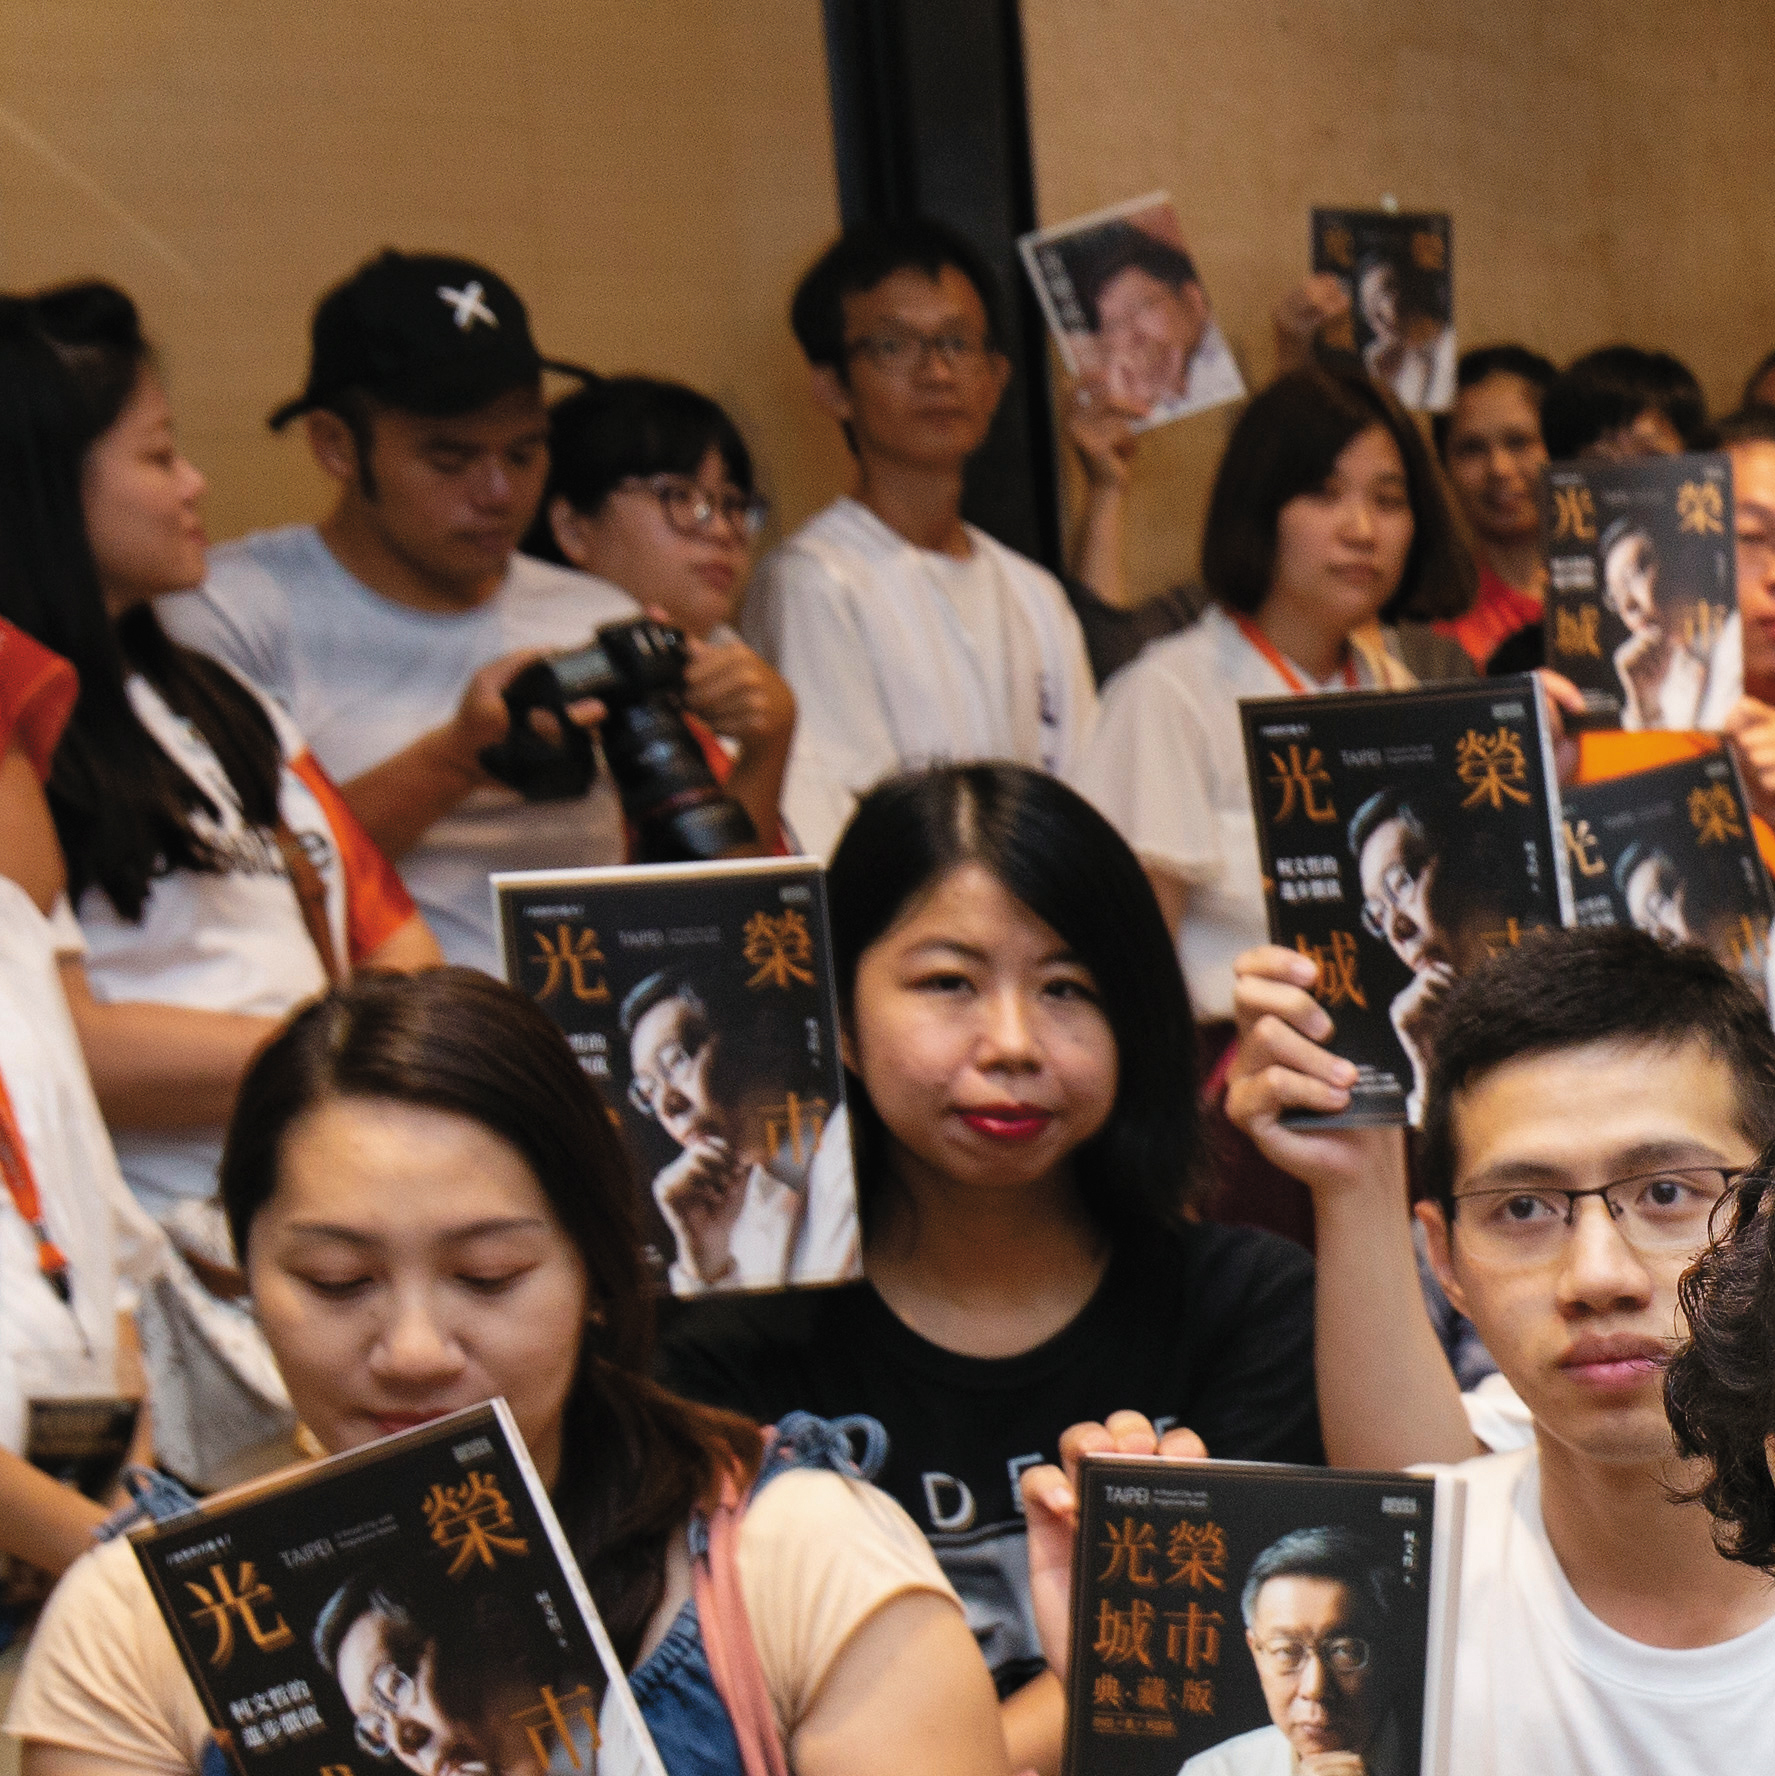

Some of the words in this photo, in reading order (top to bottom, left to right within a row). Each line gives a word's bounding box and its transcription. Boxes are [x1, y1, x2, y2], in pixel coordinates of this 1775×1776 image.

[1267, 743, 1338, 825] 光
[1455, 726, 1532, 811] 榮
[530, 923, 612, 1003] 光
[742, 908, 817, 990] 榮
[184, 1559, 296, 1671] 光
[422, 1470, 529, 1578] 榮
[1099, 1516, 1230, 1592] 光榮
[1092, 1599, 1226, 1674] 城市
